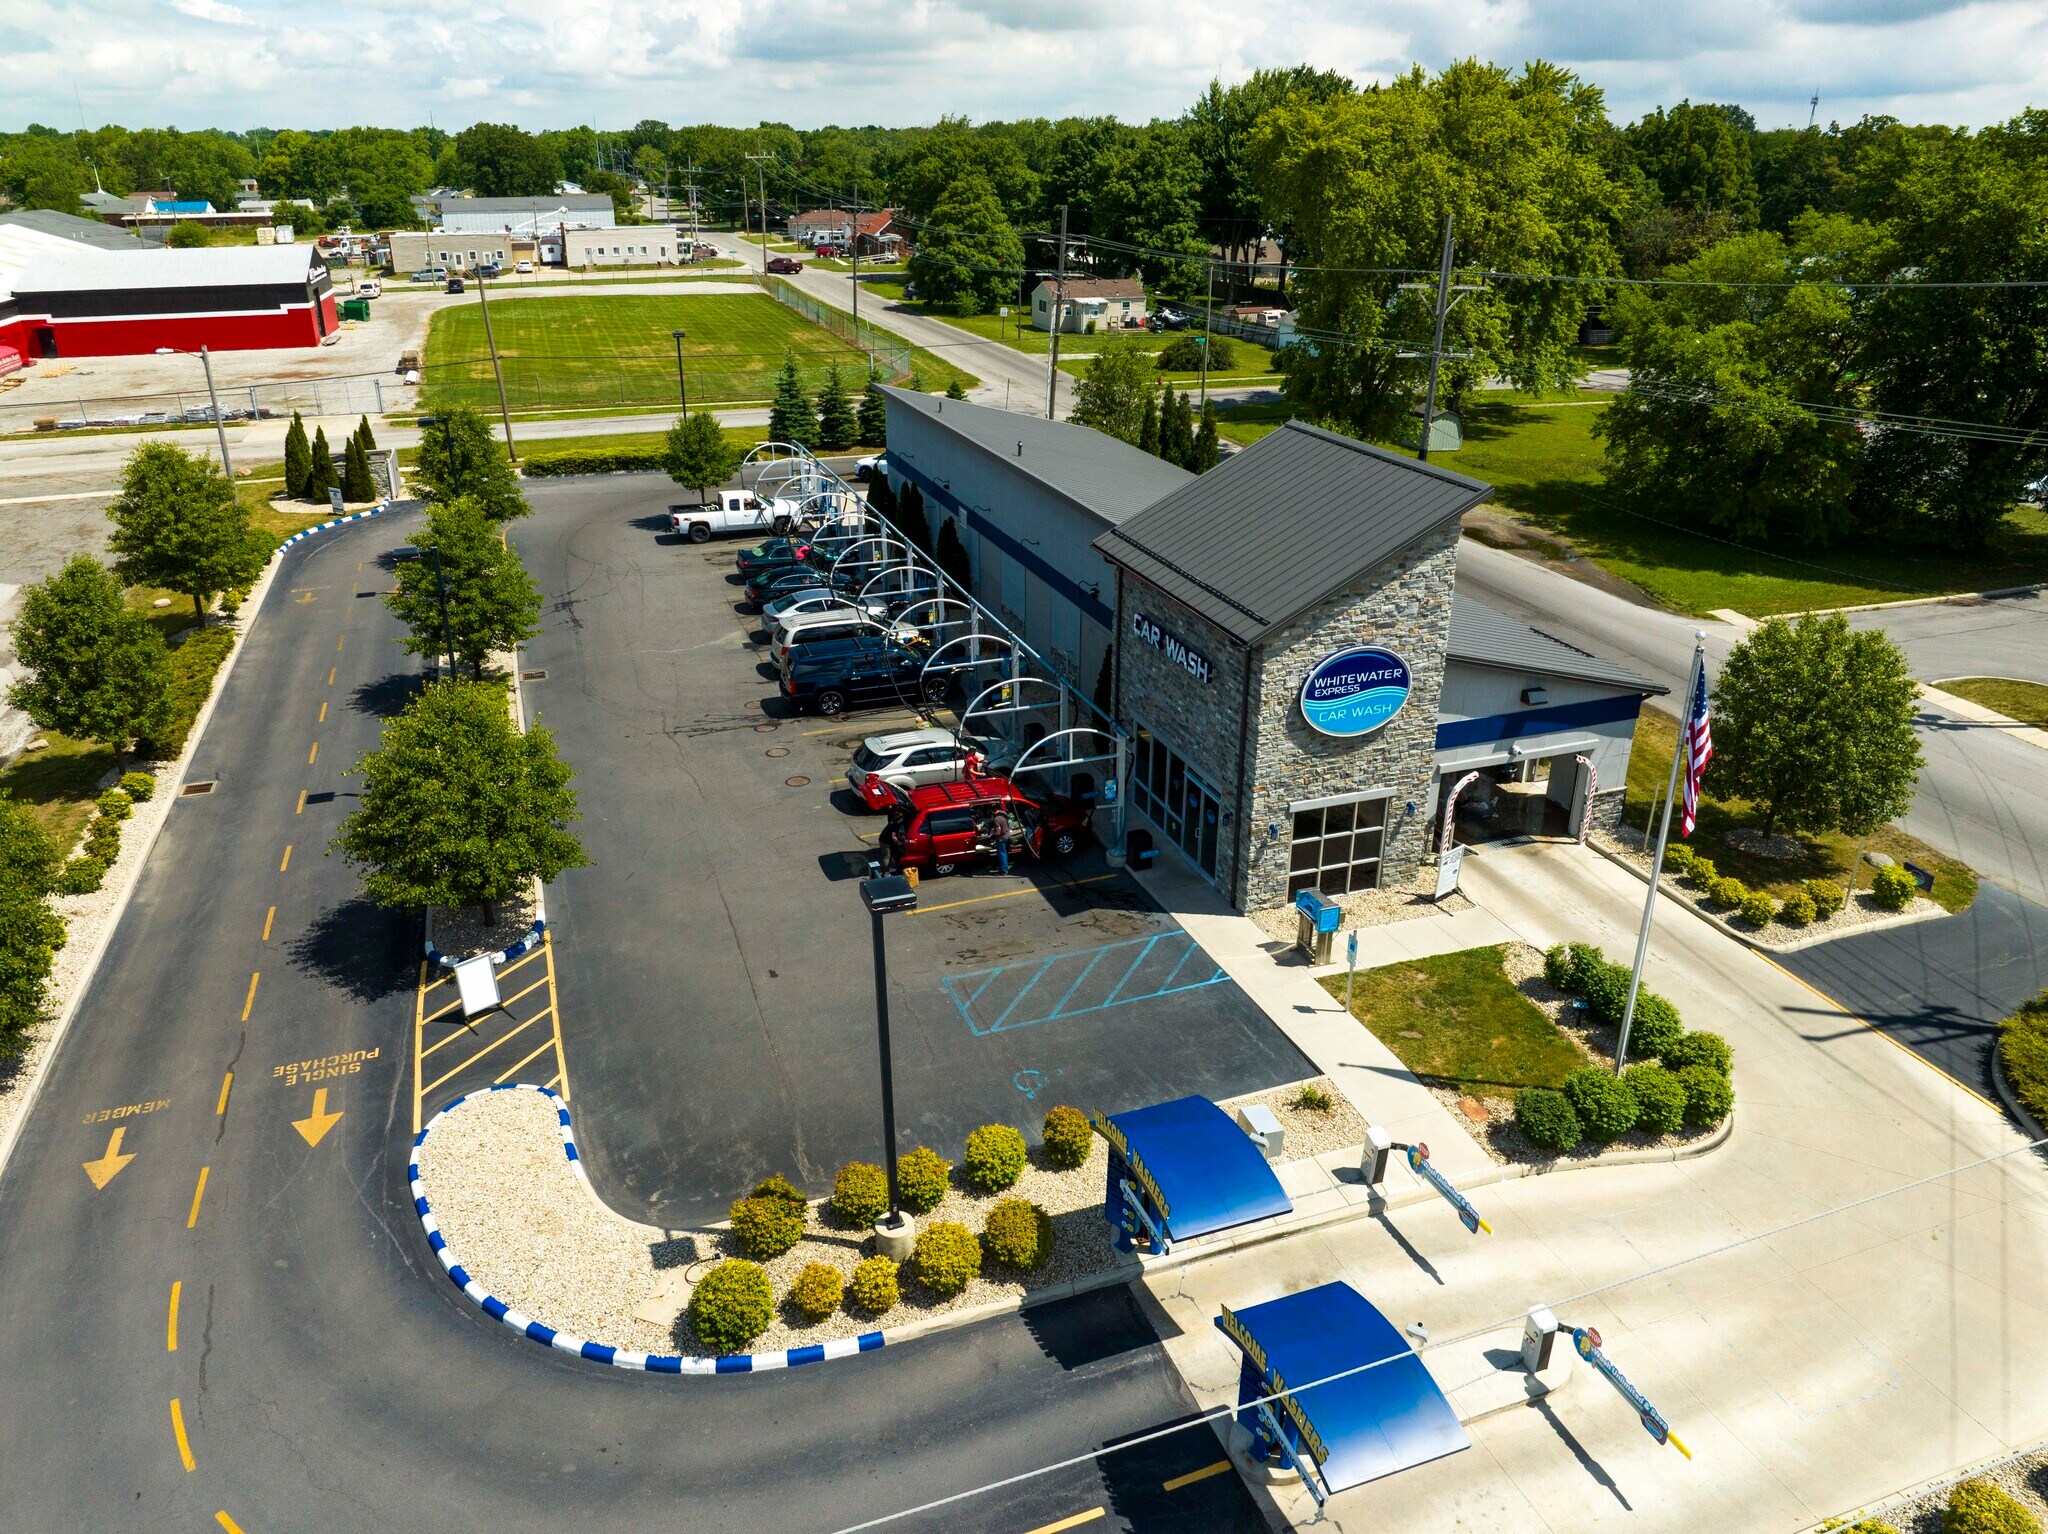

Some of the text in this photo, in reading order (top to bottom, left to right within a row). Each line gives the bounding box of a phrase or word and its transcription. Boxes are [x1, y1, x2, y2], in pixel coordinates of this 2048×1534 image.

[1133, 612, 1208, 684] CAR WASH
[1314, 668, 1403, 688] WHITEWATER
[1314, 683, 1361, 698] EXPRESS
[1319, 703, 1392, 722] CAR WASH
[273, 1047, 379, 1078] PURCHASE
[285, 1062, 361, 1086] SINGLE
[82, 1099, 171, 1125] MEMBER
[1093, 1107, 1128, 1156] WELCOME
[1132, 1147, 1170, 1220] WASHERS
[1587, 1328, 1602, 1344] STOP
[1221, 1303, 1267, 1373] WELCOME
[1273, 1367, 1329, 1466] WASHERS
[1594, 1347, 1613, 1370] Wash
[1611, 1366, 1645, 1404] Unlimited
[1650, 1407, 1668, 1430] Save
